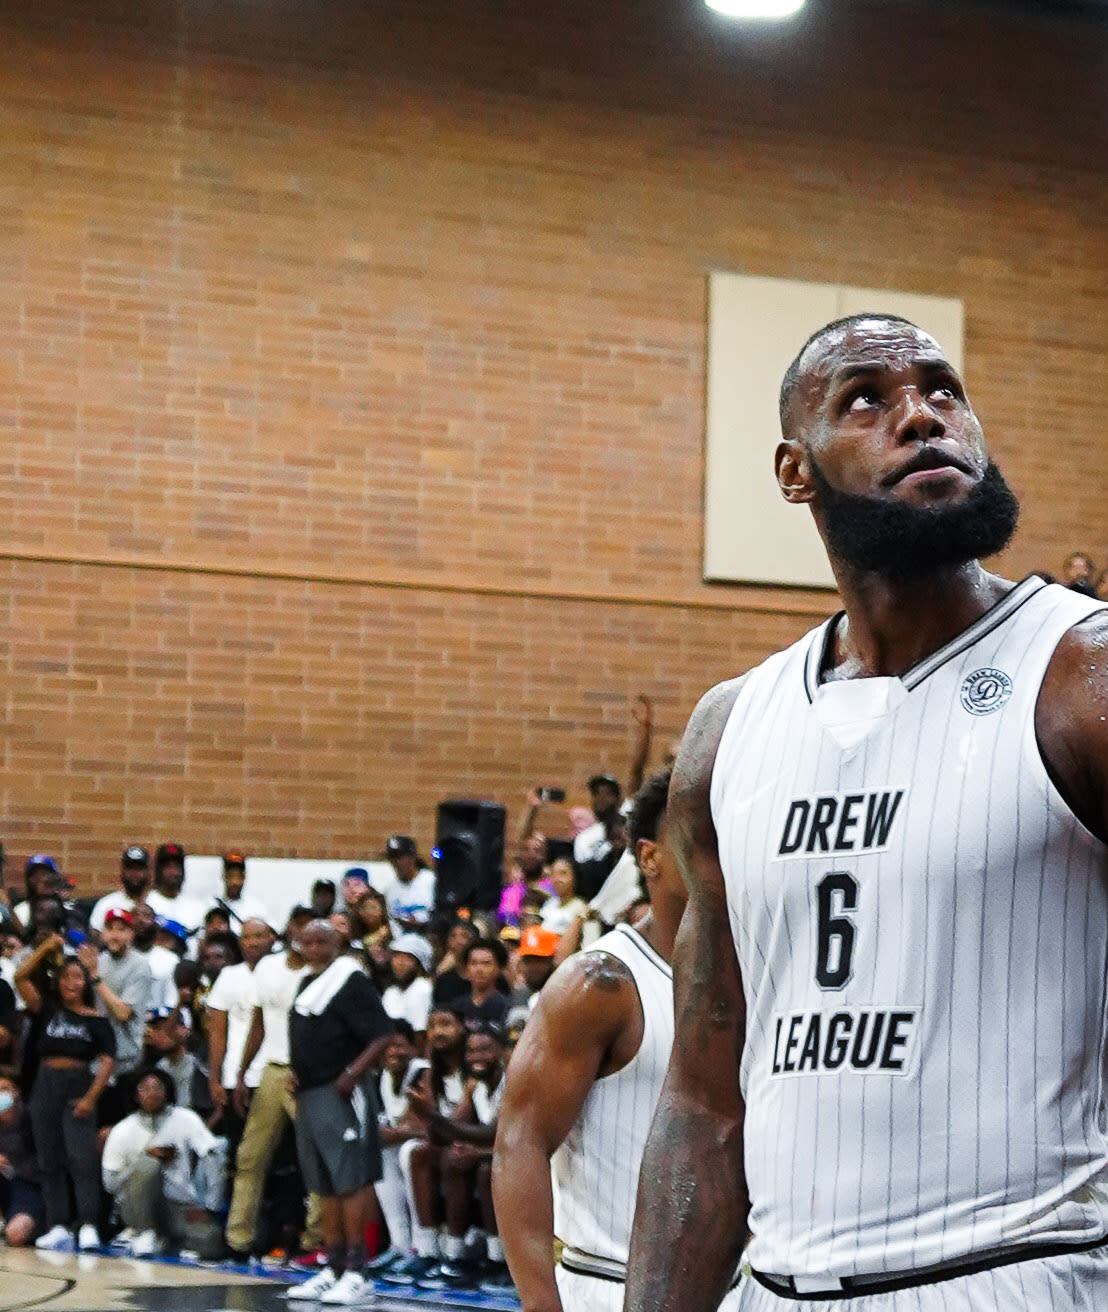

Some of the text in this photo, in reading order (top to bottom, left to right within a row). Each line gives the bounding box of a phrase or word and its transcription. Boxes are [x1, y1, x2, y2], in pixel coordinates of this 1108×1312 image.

[777, 790, 905, 857] DREW
[815, 870, 860, 992] 6
[771, 1012, 915, 1075] LEAGUE
